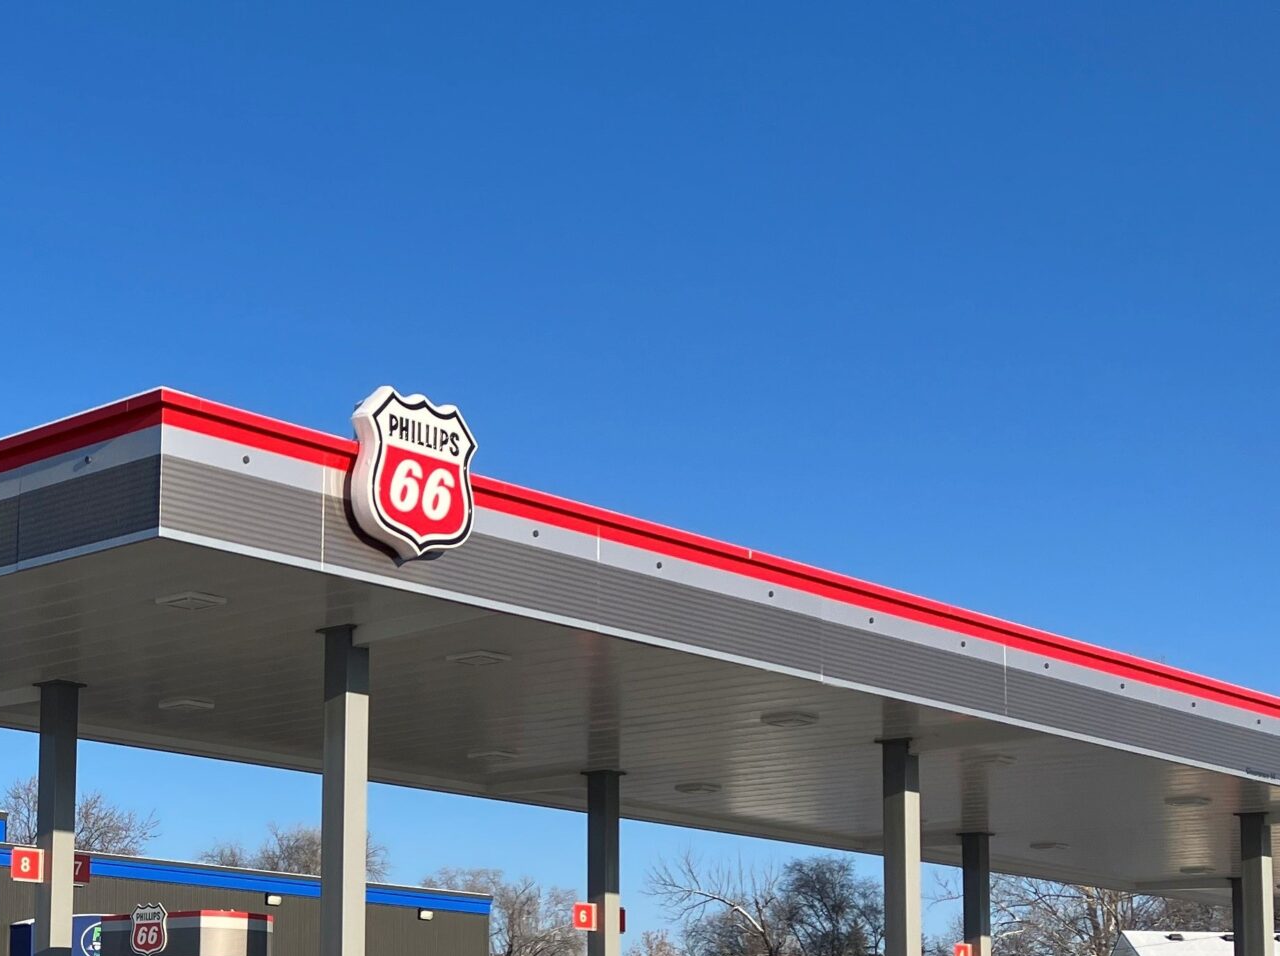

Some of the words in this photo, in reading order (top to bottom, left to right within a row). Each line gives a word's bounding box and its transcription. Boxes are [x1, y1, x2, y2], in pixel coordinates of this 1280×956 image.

[389, 413, 460, 457] PHILLIPS
[389, 459, 456, 522] 66
[21, 856, 30, 873] 8
[74, 861, 83, 876] 7
[136, 911, 161, 921] PHILLIPS
[580, 909, 588, 923] 6
[137, 926, 159, 945] 66
